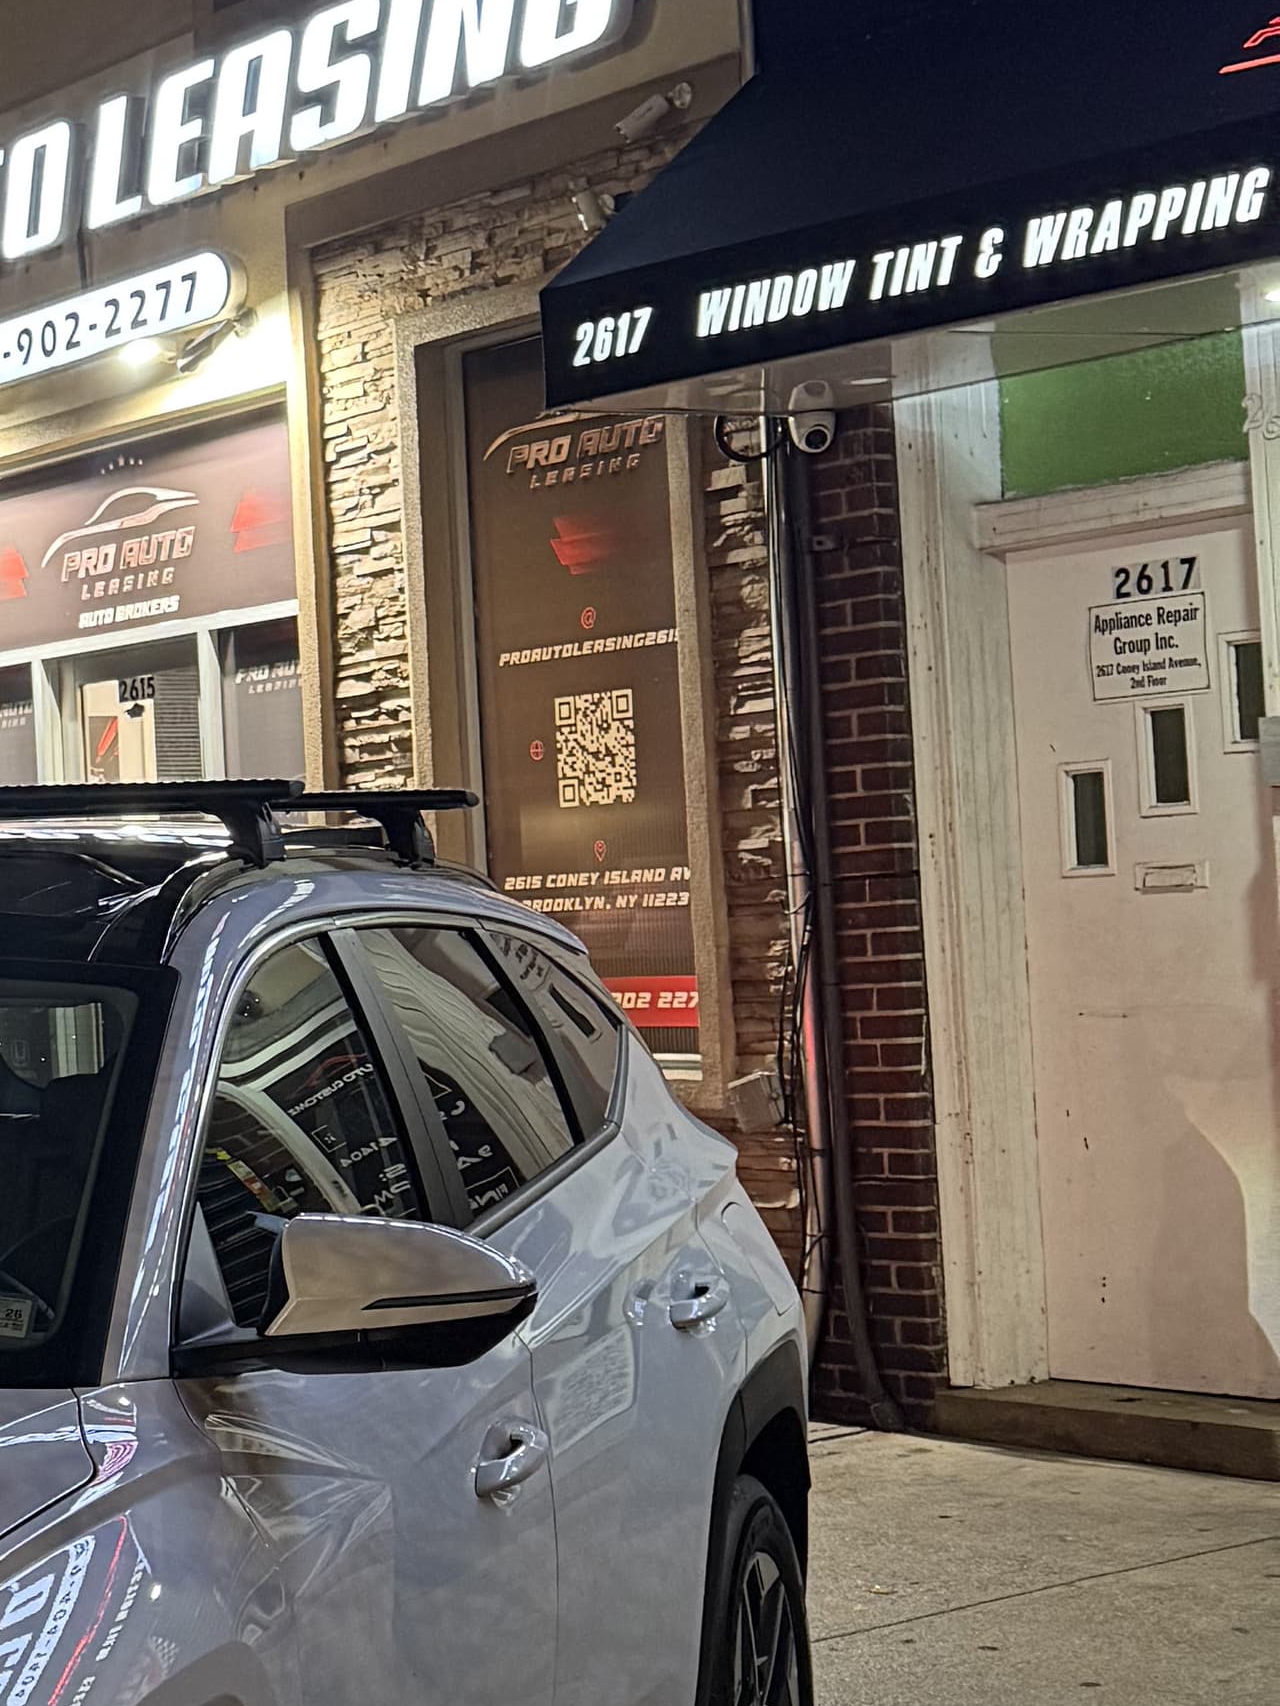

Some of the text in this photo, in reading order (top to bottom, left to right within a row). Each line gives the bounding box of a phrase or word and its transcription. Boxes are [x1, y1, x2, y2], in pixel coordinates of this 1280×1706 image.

[572, 164, 1269, 367] 2617 WINDOW TINT & WRAPPING
[507, 413, 665, 474] PRO AUTO
[530, 454, 641, 490] LEASING
[61, 526, 195, 582] PRO AUTO
[81, 567, 175, 600] LEASING
[1114, 556, 1197, 599] 2617
[79, 596, 180, 629] AUTO BROKERS
[1094, 603, 1200, 635] Appliance Repair
[1114, 632, 1179, 655] Group Inc.
[1116, 663, 1140, 675] Coney
[1143, 658, 1166, 671] Island
[1130, 675, 1167, 689] 2nd Floor
[120, 676, 156, 703] 2615
[504, 876, 542, 891] 2615
[546, 872, 600, 888] CONEY
[604, 868, 666, 885] ISLAND
[616, 895, 638, 908] NY
[642, 892, 690, 908] 11223
